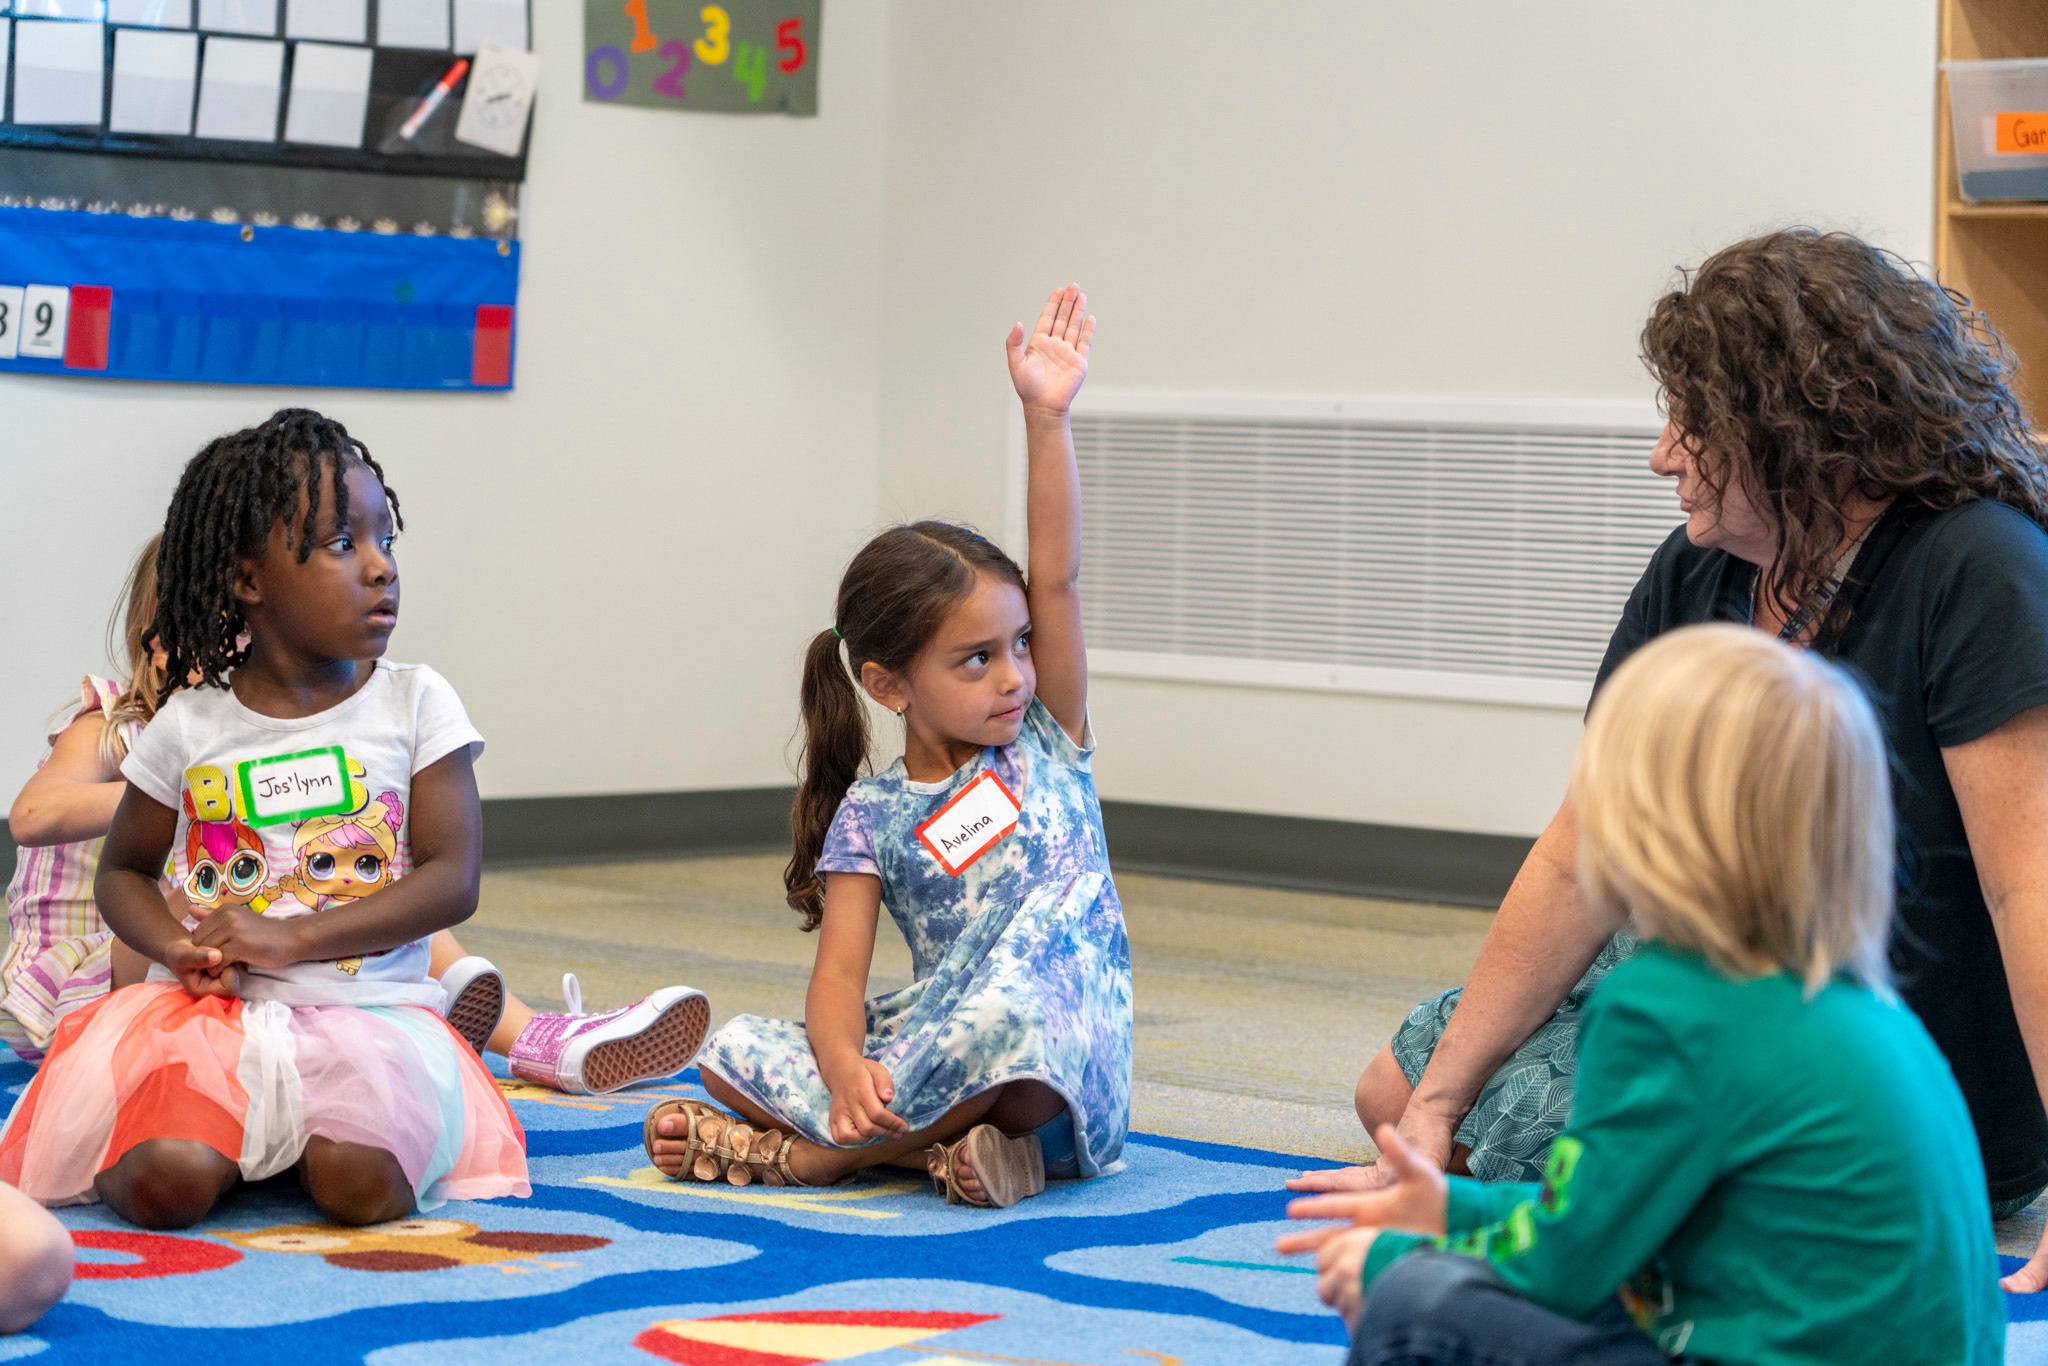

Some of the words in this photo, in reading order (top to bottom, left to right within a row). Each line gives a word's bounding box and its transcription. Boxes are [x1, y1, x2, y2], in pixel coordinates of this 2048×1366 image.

[586, 45, 630, 99] 0
[623, 0, 657, 54] 1
[653, 39, 691, 99] 2
[693, 5, 730, 65] 3
[734, 42, 767, 103] 4
[775, 16, 807, 73] 5
[35, 301, 53, 337] 9
[258, 772, 333, 798] Jos'lynn
[940, 815, 994, 854] Avelina
